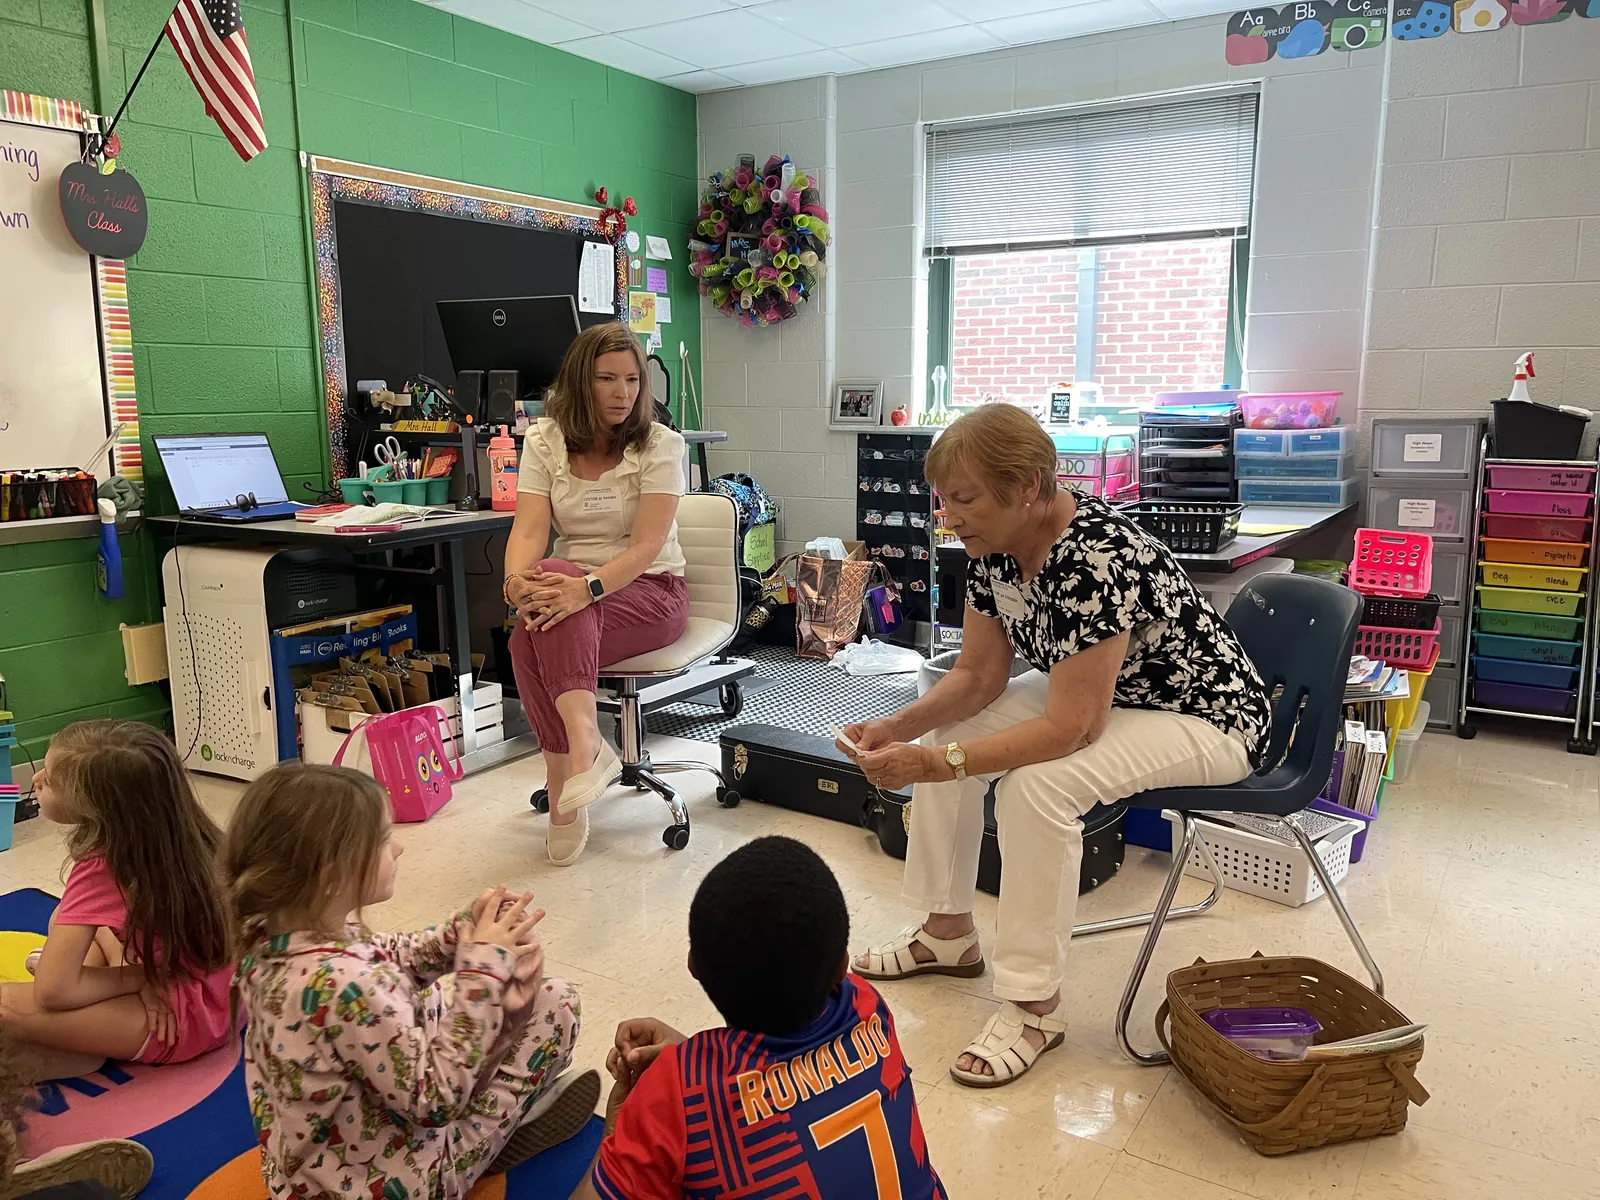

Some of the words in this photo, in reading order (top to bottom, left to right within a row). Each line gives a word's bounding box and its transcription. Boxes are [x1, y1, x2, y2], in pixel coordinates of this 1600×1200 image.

[1294, 3, 1317, 21] Bb
[1347, 0, 1371, 12] Cc
[1362, 7, 1387, 17] camera
[1397, 7, 1412, 16] dice
[1239, 11, 1264, 28] Aa
[1278, 26, 1291, 36] bird
[87, 210, 122, 233] Class
[731, 237, 751, 249] MRS.
[420, 421, 437, 432] Hall
[1551, 504, 1572, 515] floss
[750, 534, 768, 549] School
[746, 552, 771, 568] Supplies
[1544, 550, 1577, 562] Digraphs
[387, 624, 408, 638] Books
[941, 630, 963, 640] SOCIA
[736, 1012, 892, 1127] RONALDO
[808, 1089, 903, 1200] 7
